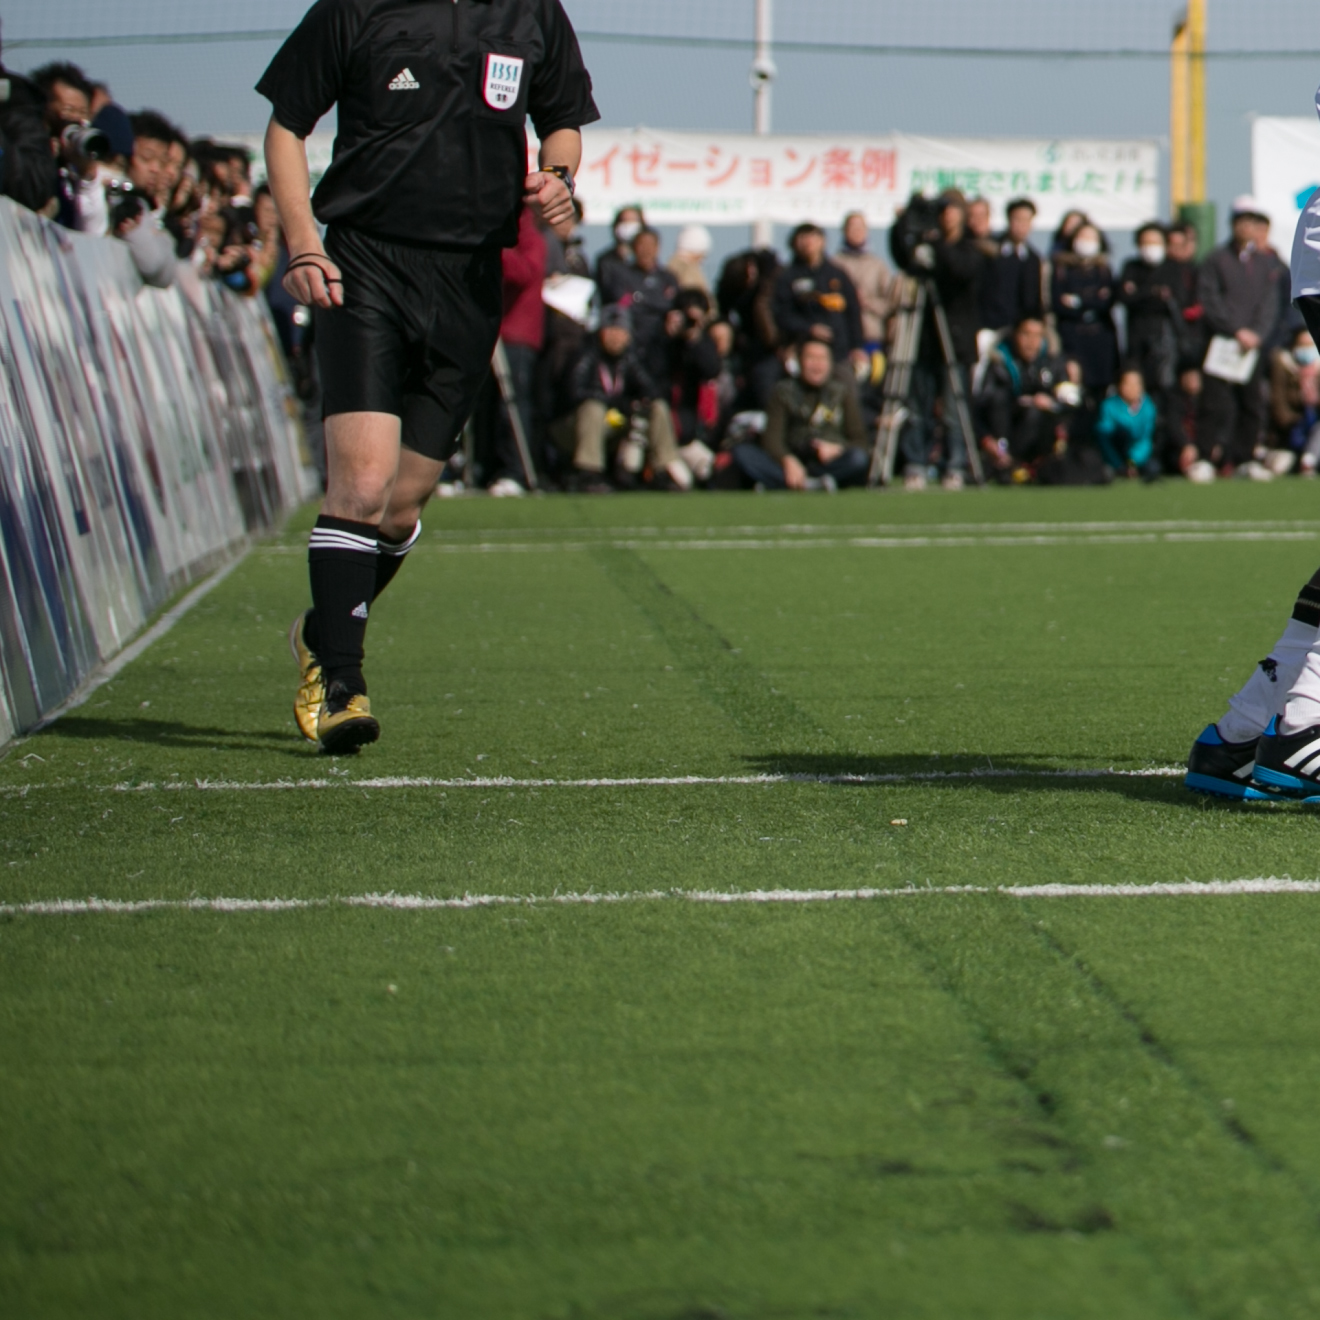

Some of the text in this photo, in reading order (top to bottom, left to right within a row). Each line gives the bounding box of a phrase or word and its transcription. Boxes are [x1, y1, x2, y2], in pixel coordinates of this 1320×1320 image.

[388, 81, 420, 90] adidas
[528, 142, 897, 191] イゼーション条例
